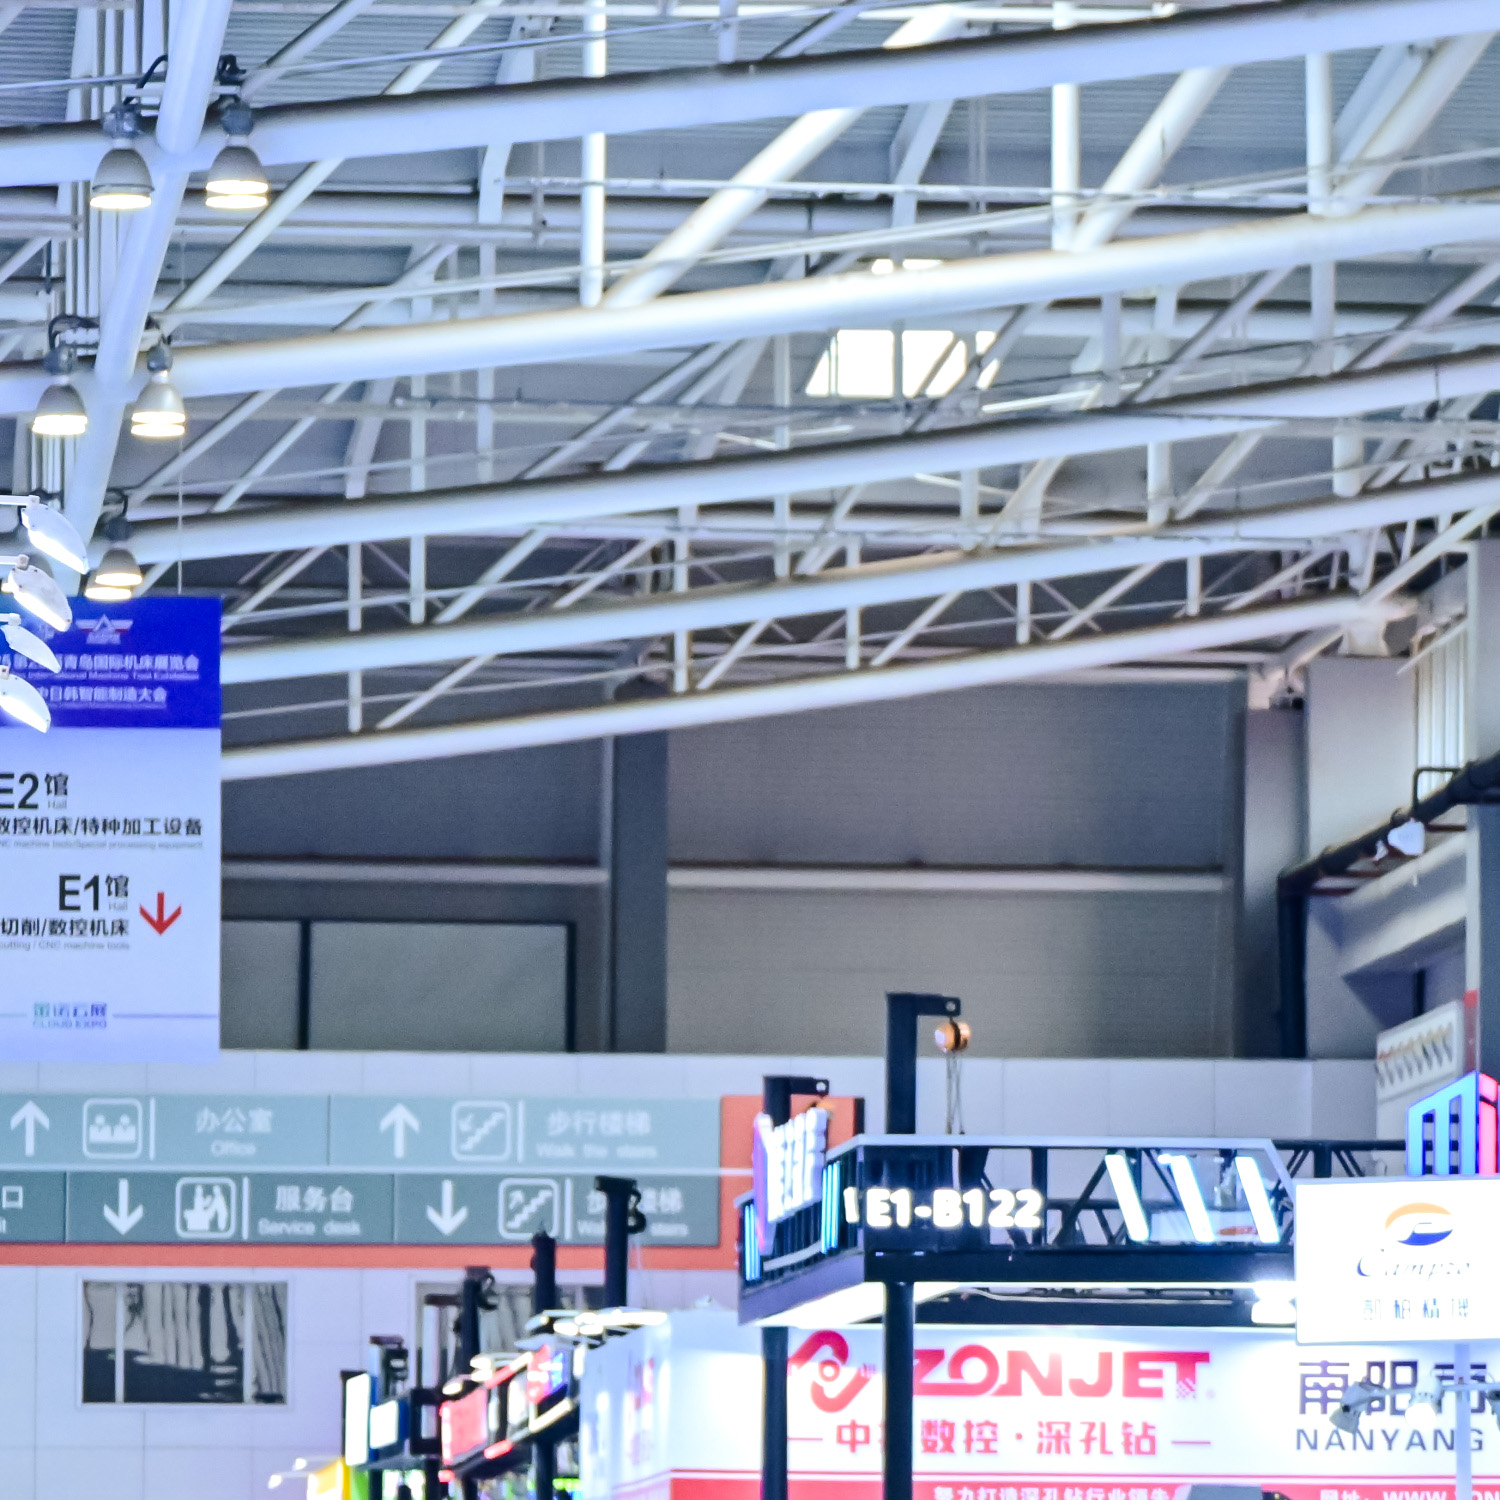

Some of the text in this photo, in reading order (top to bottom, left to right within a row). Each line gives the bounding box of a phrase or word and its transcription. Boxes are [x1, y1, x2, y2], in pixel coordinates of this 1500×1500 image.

[196, 1107, 273, 1134] 办公室
[211, 1140, 257, 1156] Office
[275, 1185, 354, 1213] 服务台
[865, 1187, 1043, 1228] E1-B122
[258, 1218, 362, 1236] Service desk
[913, 1344, 1210, 1399] ZONJET
[836, 1419, 1158, 1456] 中数控·深孔钻
[1296, 1428, 1485, 1452] NANYANG
